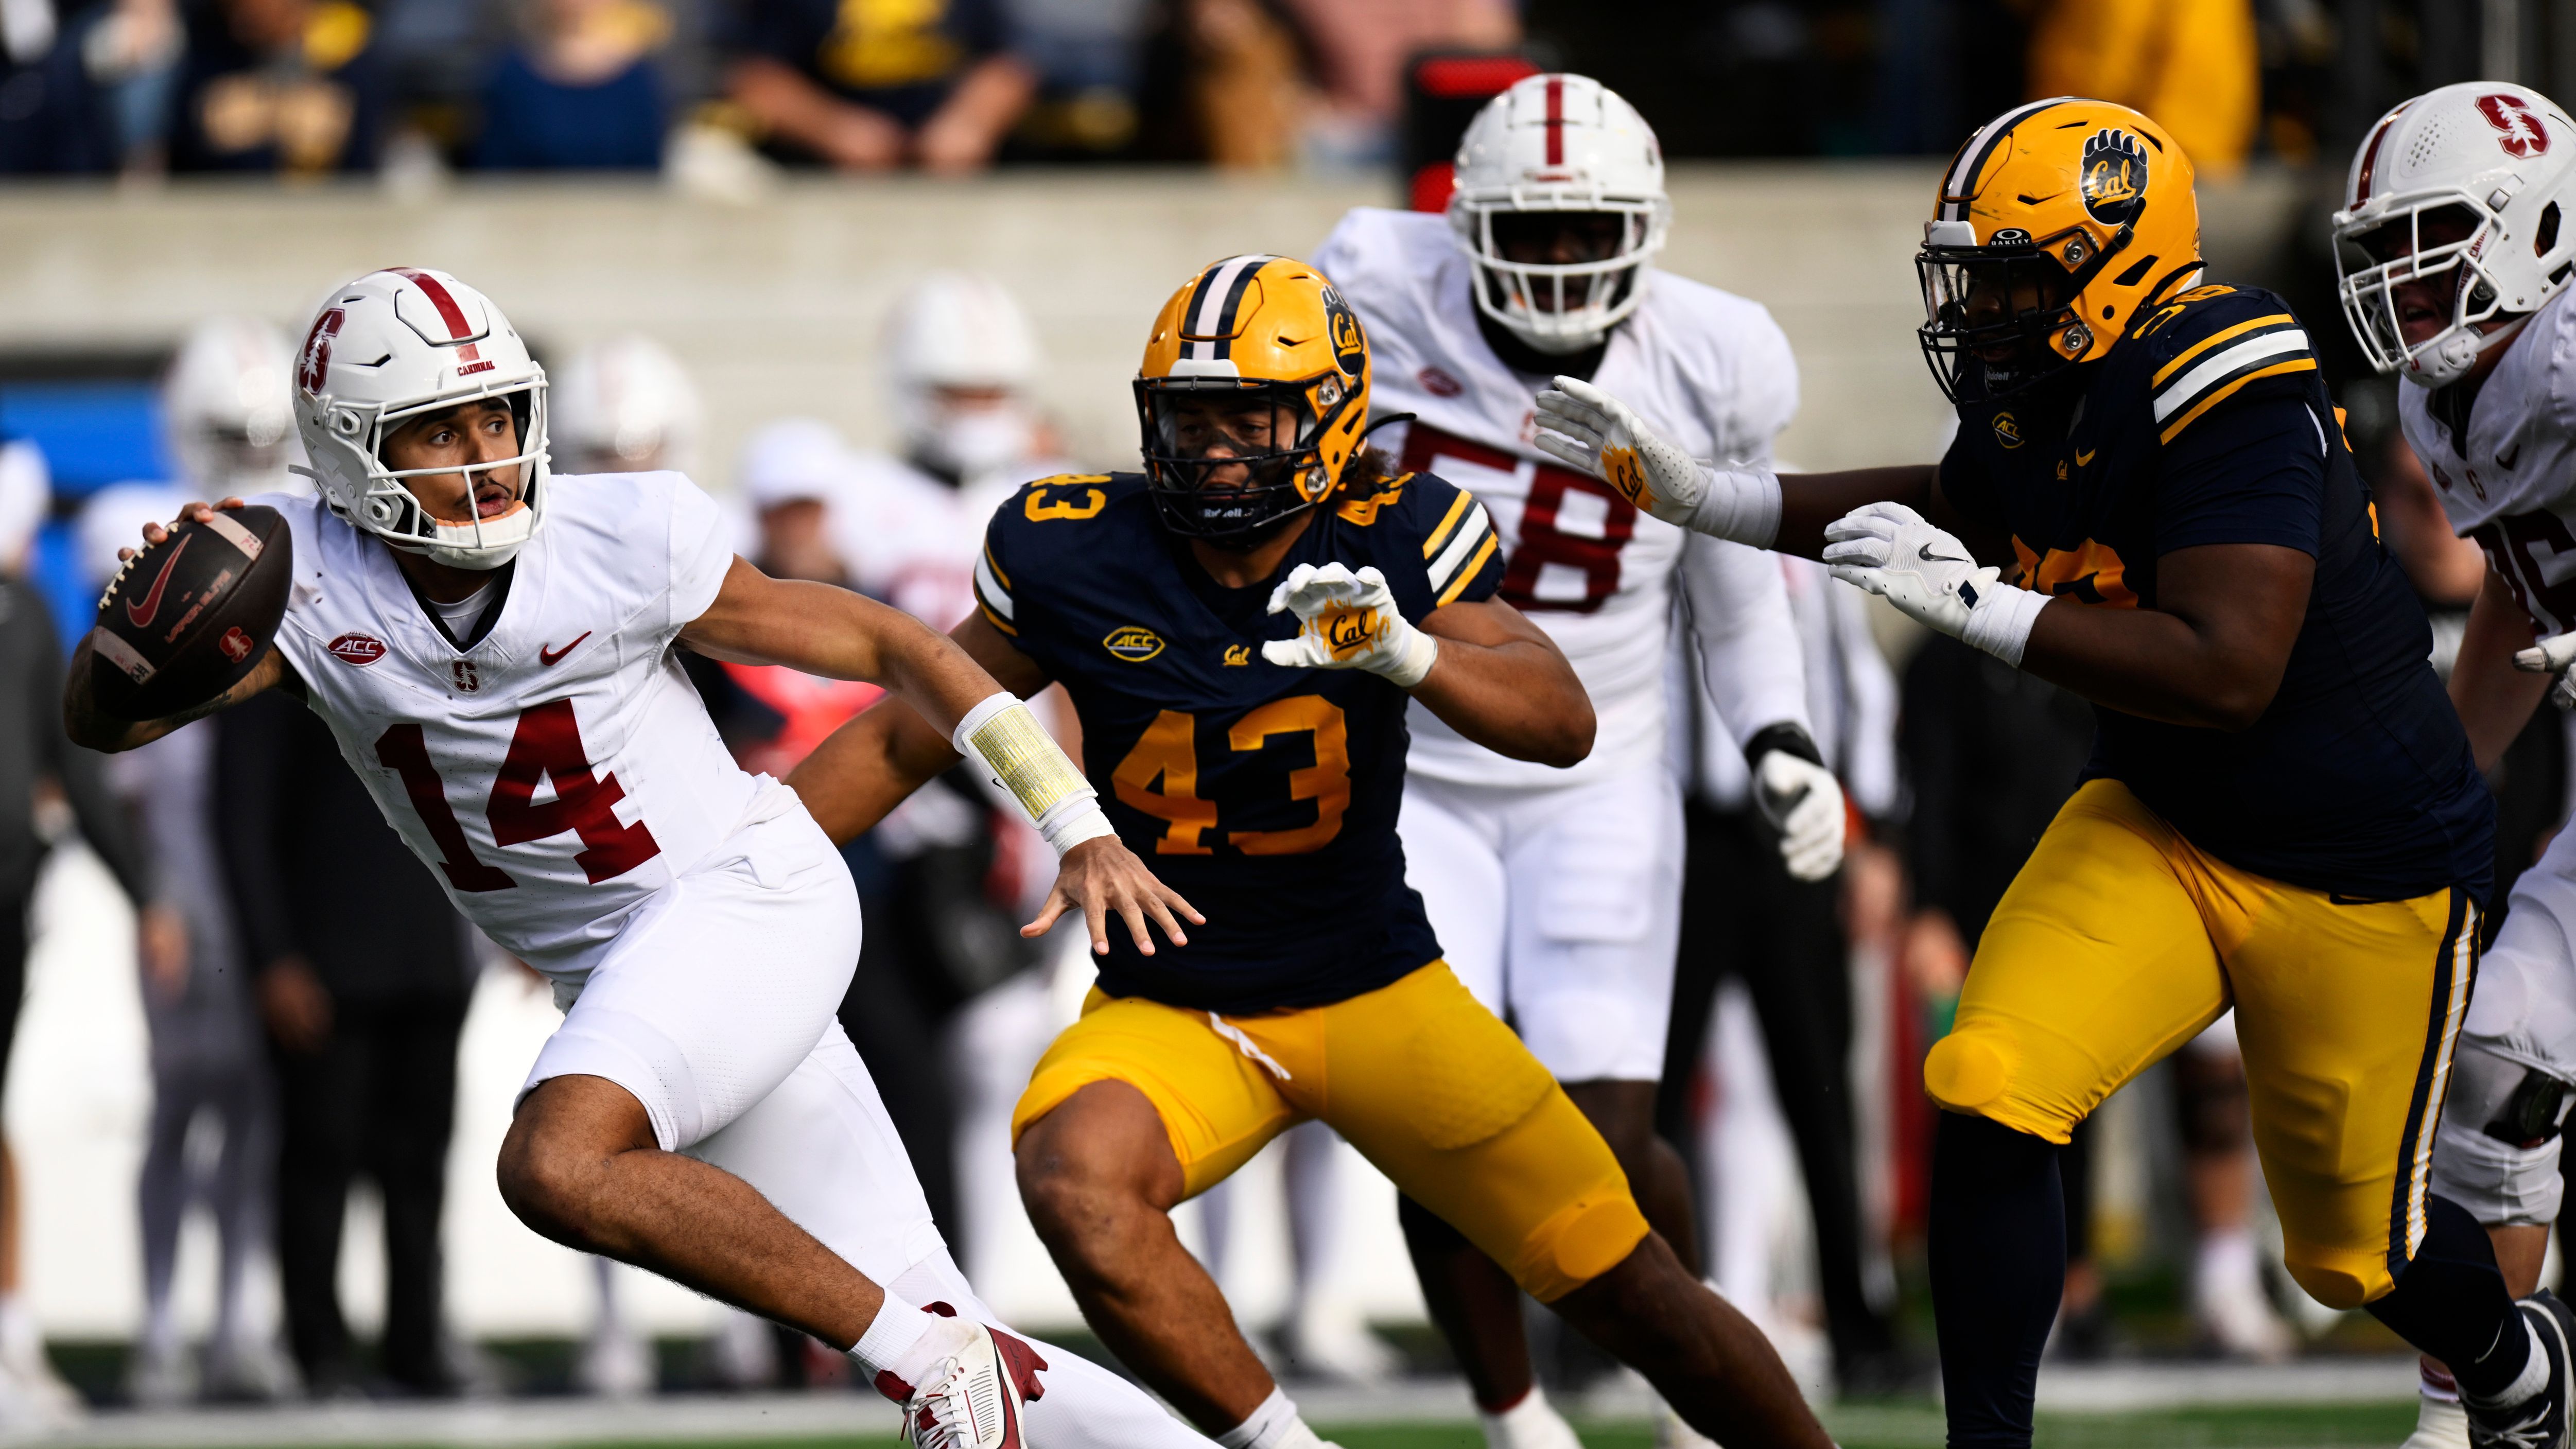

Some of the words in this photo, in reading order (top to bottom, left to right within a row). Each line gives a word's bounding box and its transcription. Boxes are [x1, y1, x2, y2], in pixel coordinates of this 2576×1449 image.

[2087, 159, 2136, 208] Cal
[1333, 312, 1362, 357] Cal
[457, 360, 495, 376] CARDINAL
[1617, 456, 1642, 503] Cal
[335, 640, 379, 654] ACC
[1113, 635, 1155, 648] ACC
[1329, 610, 1372, 653] Cal
[1223, 644, 1250, 666] Cal
[375, 698, 661, 893] 14
[1111, 694, 1351, 856] 43
